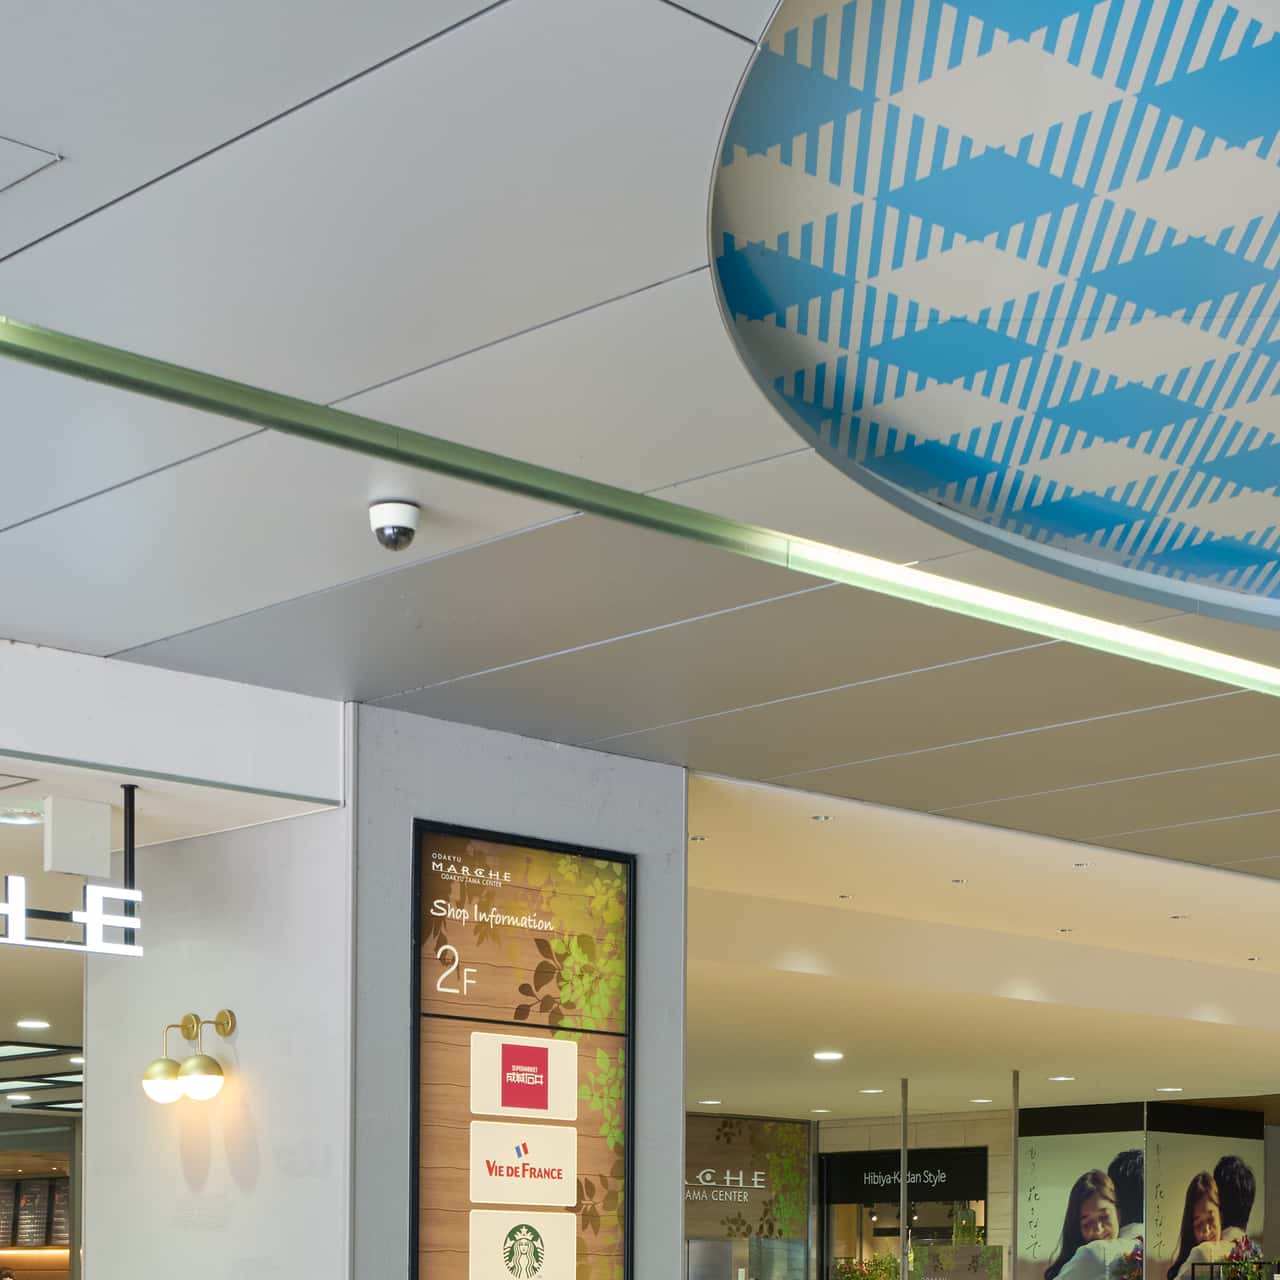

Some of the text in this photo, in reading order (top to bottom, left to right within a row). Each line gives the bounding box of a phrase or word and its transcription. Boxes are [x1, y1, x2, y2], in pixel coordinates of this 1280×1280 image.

[431, 852, 462, 863] ODAKYU
[432, 861, 512, 882] MARCHE
[430, 899, 554, 931] Shop Information
[436, 944, 478, 995] 2F
[506, 1165, 521, 1178] DE
[522, 1162, 563, 1180] FRANCE
[685, 1168, 766, 1188] CHE
[923, 1169, 947, 1187] Style
[711, 1190, 749, 1202] CENTER
